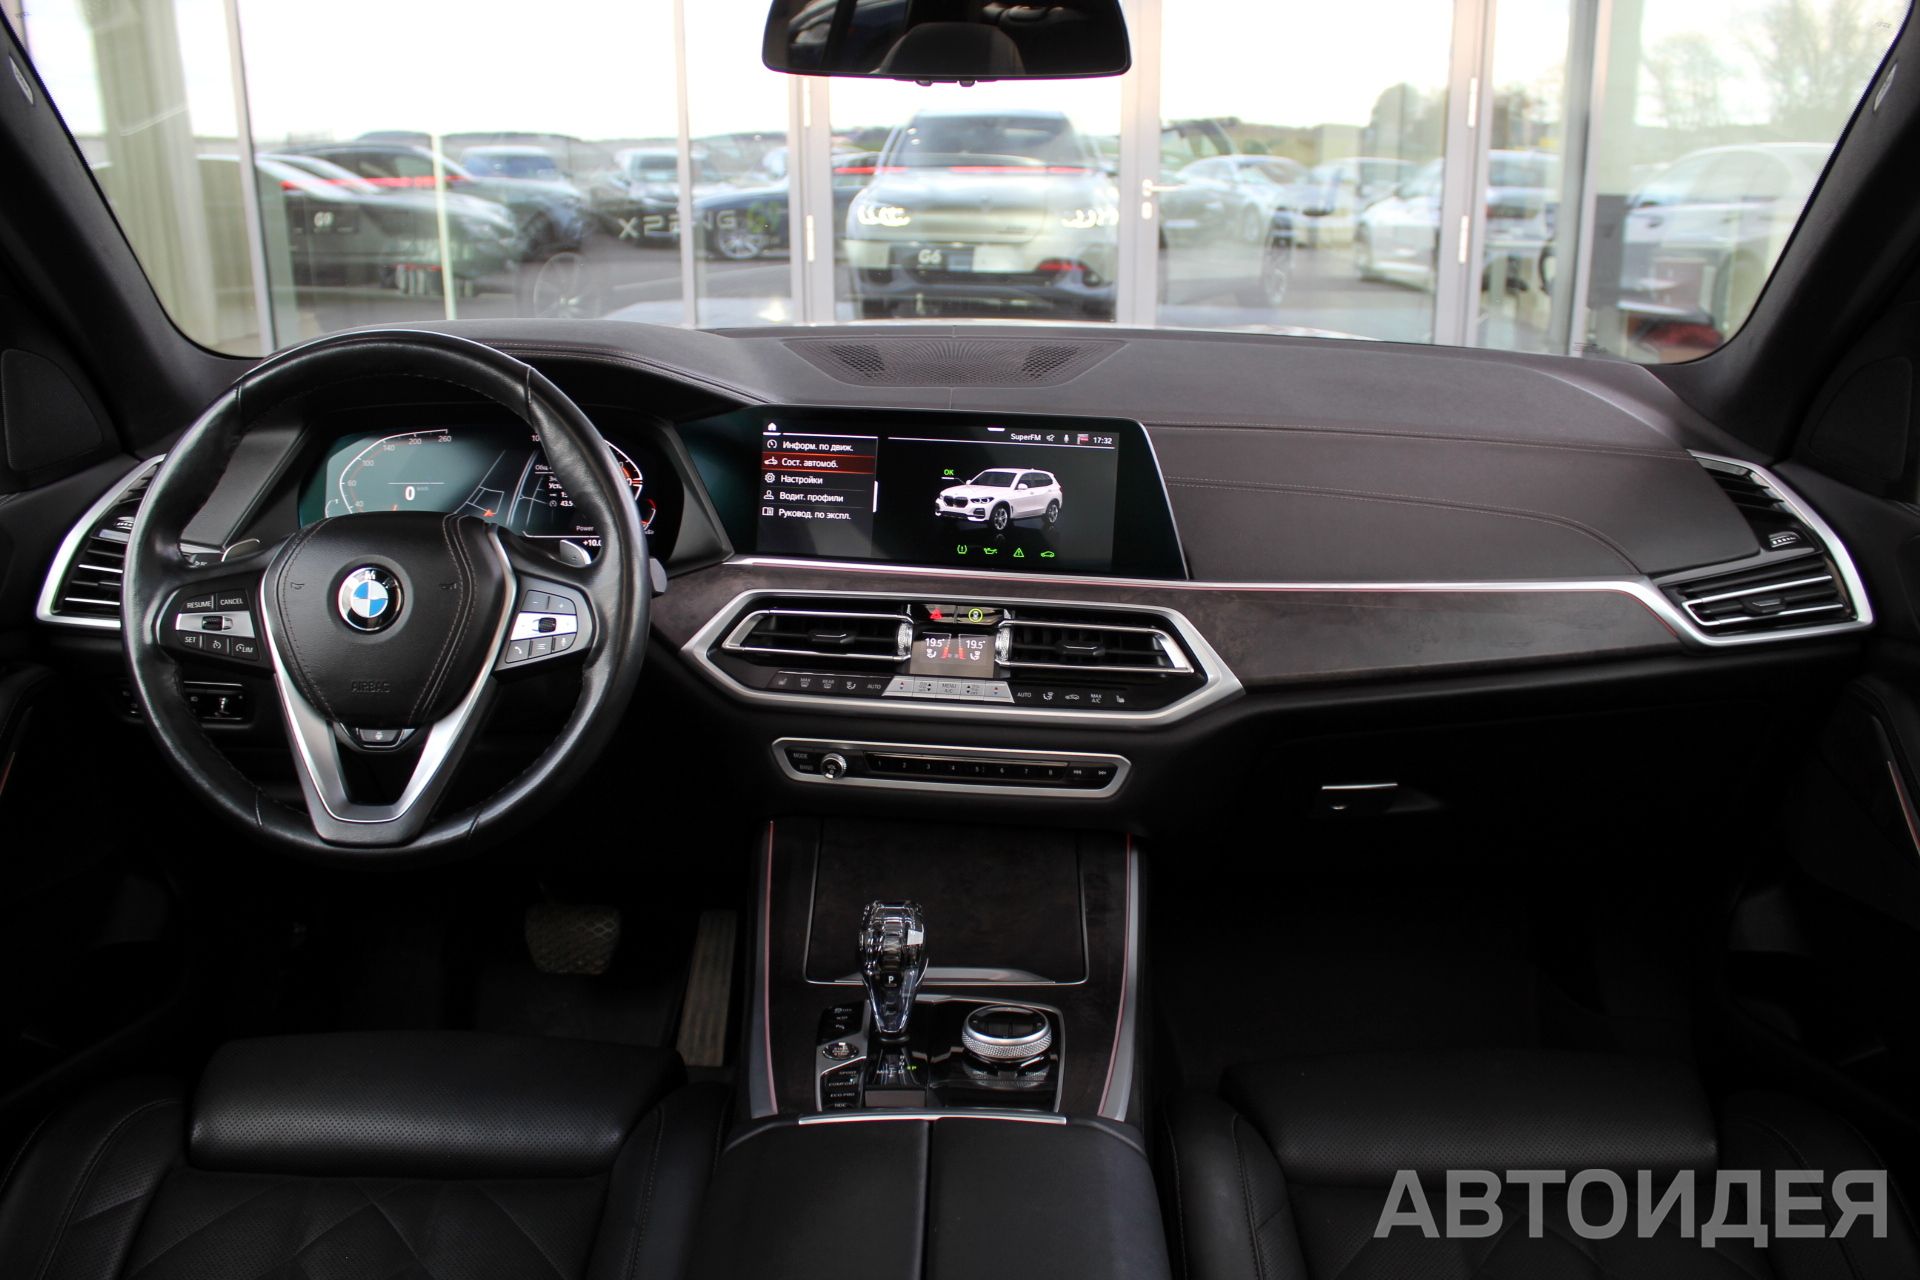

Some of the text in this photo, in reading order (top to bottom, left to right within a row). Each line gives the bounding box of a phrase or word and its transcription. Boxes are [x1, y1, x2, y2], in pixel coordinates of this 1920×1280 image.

[918, 248, 942, 265] G6
[438, 435, 452, 443] 260
[1010, 433, 1113, 445] SuperFM 17:32
[782, 441, 854, 452] Информ. по движ.
[781, 458, 839, 468] Сост. автомоб.
[943, 468, 955, 476] OK
[780, 474, 823, 485] Настройки
[404, 485, 416, 501] 0
[779, 491, 844, 503] Водит. профили
[778, 508, 852, 520] Руковод. по экспл.
[186, 600, 212, 609] RESUME
[220, 598, 244, 606] CANCEL
[888, 975, 895, 984] P
